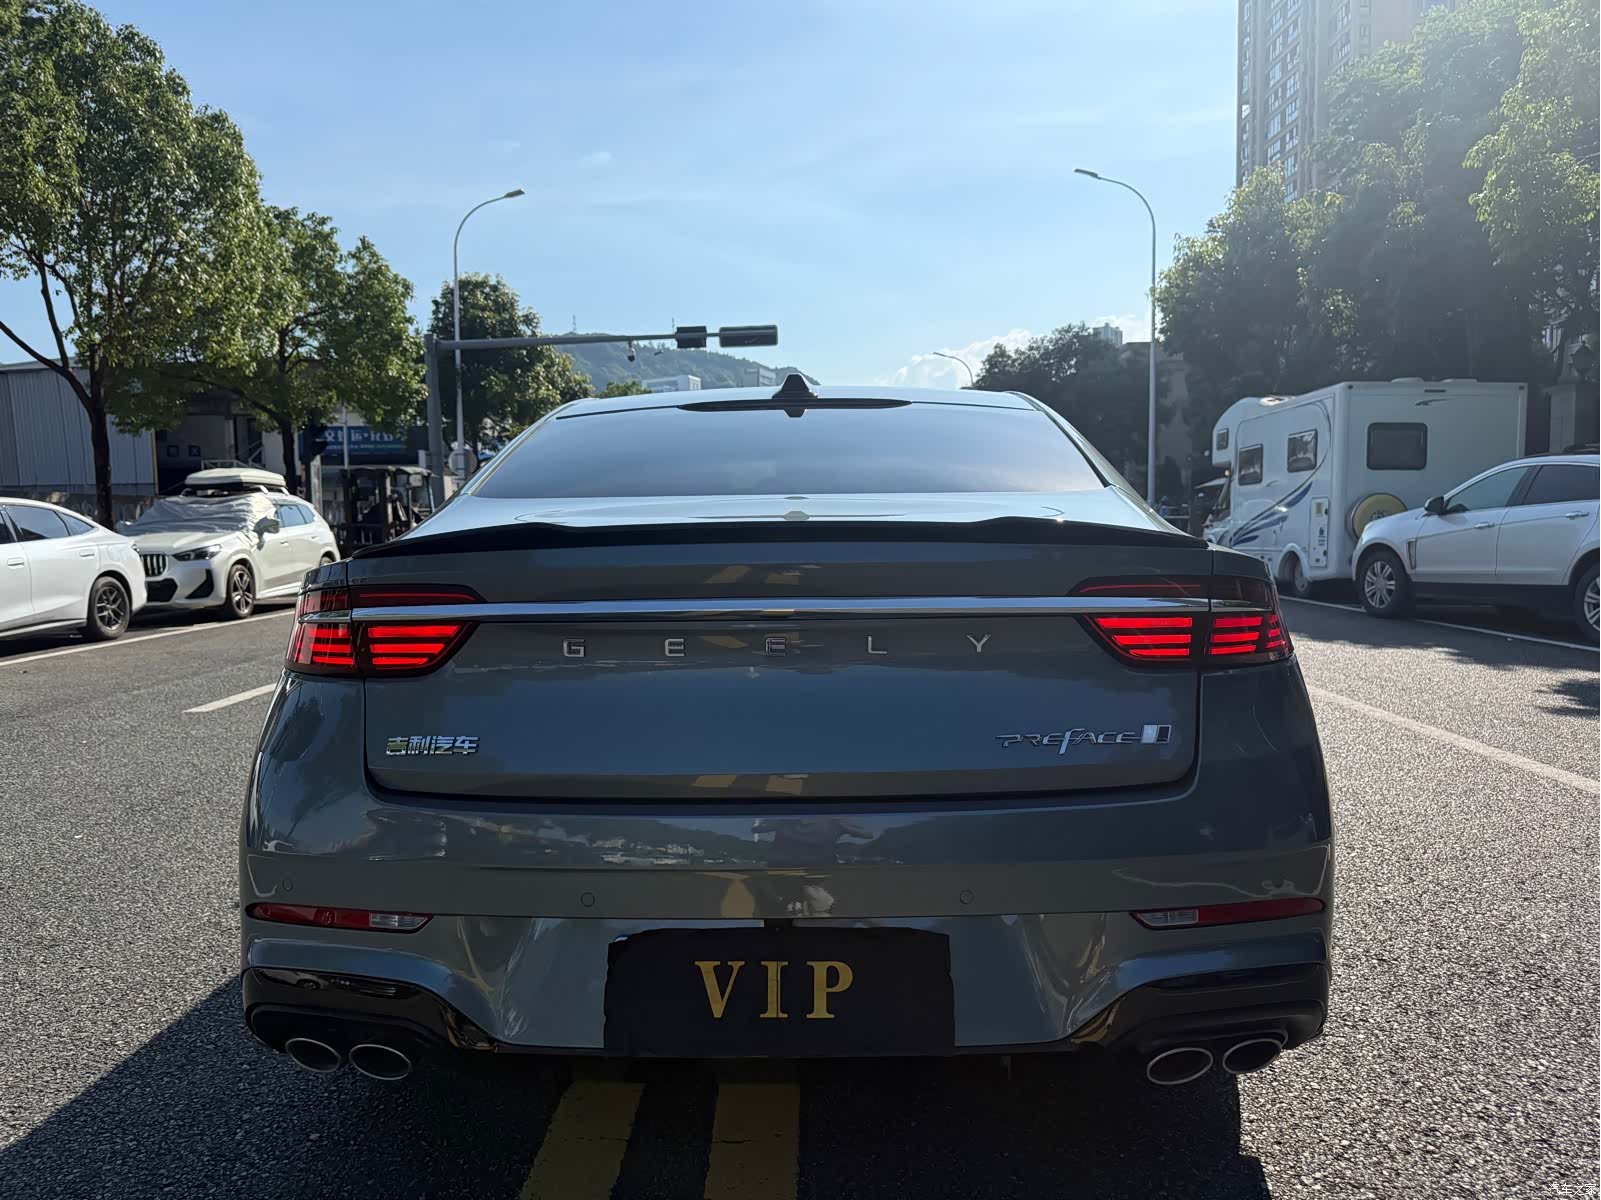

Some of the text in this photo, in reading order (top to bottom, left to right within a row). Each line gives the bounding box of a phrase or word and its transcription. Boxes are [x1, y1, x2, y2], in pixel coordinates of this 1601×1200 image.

[562, 634, 991, 658] GEELY
[386, 735, 479, 755] 吉利汽车
[995, 728, 1140, 755] PREFACE
[694, 960, 853, 1019] VIP
